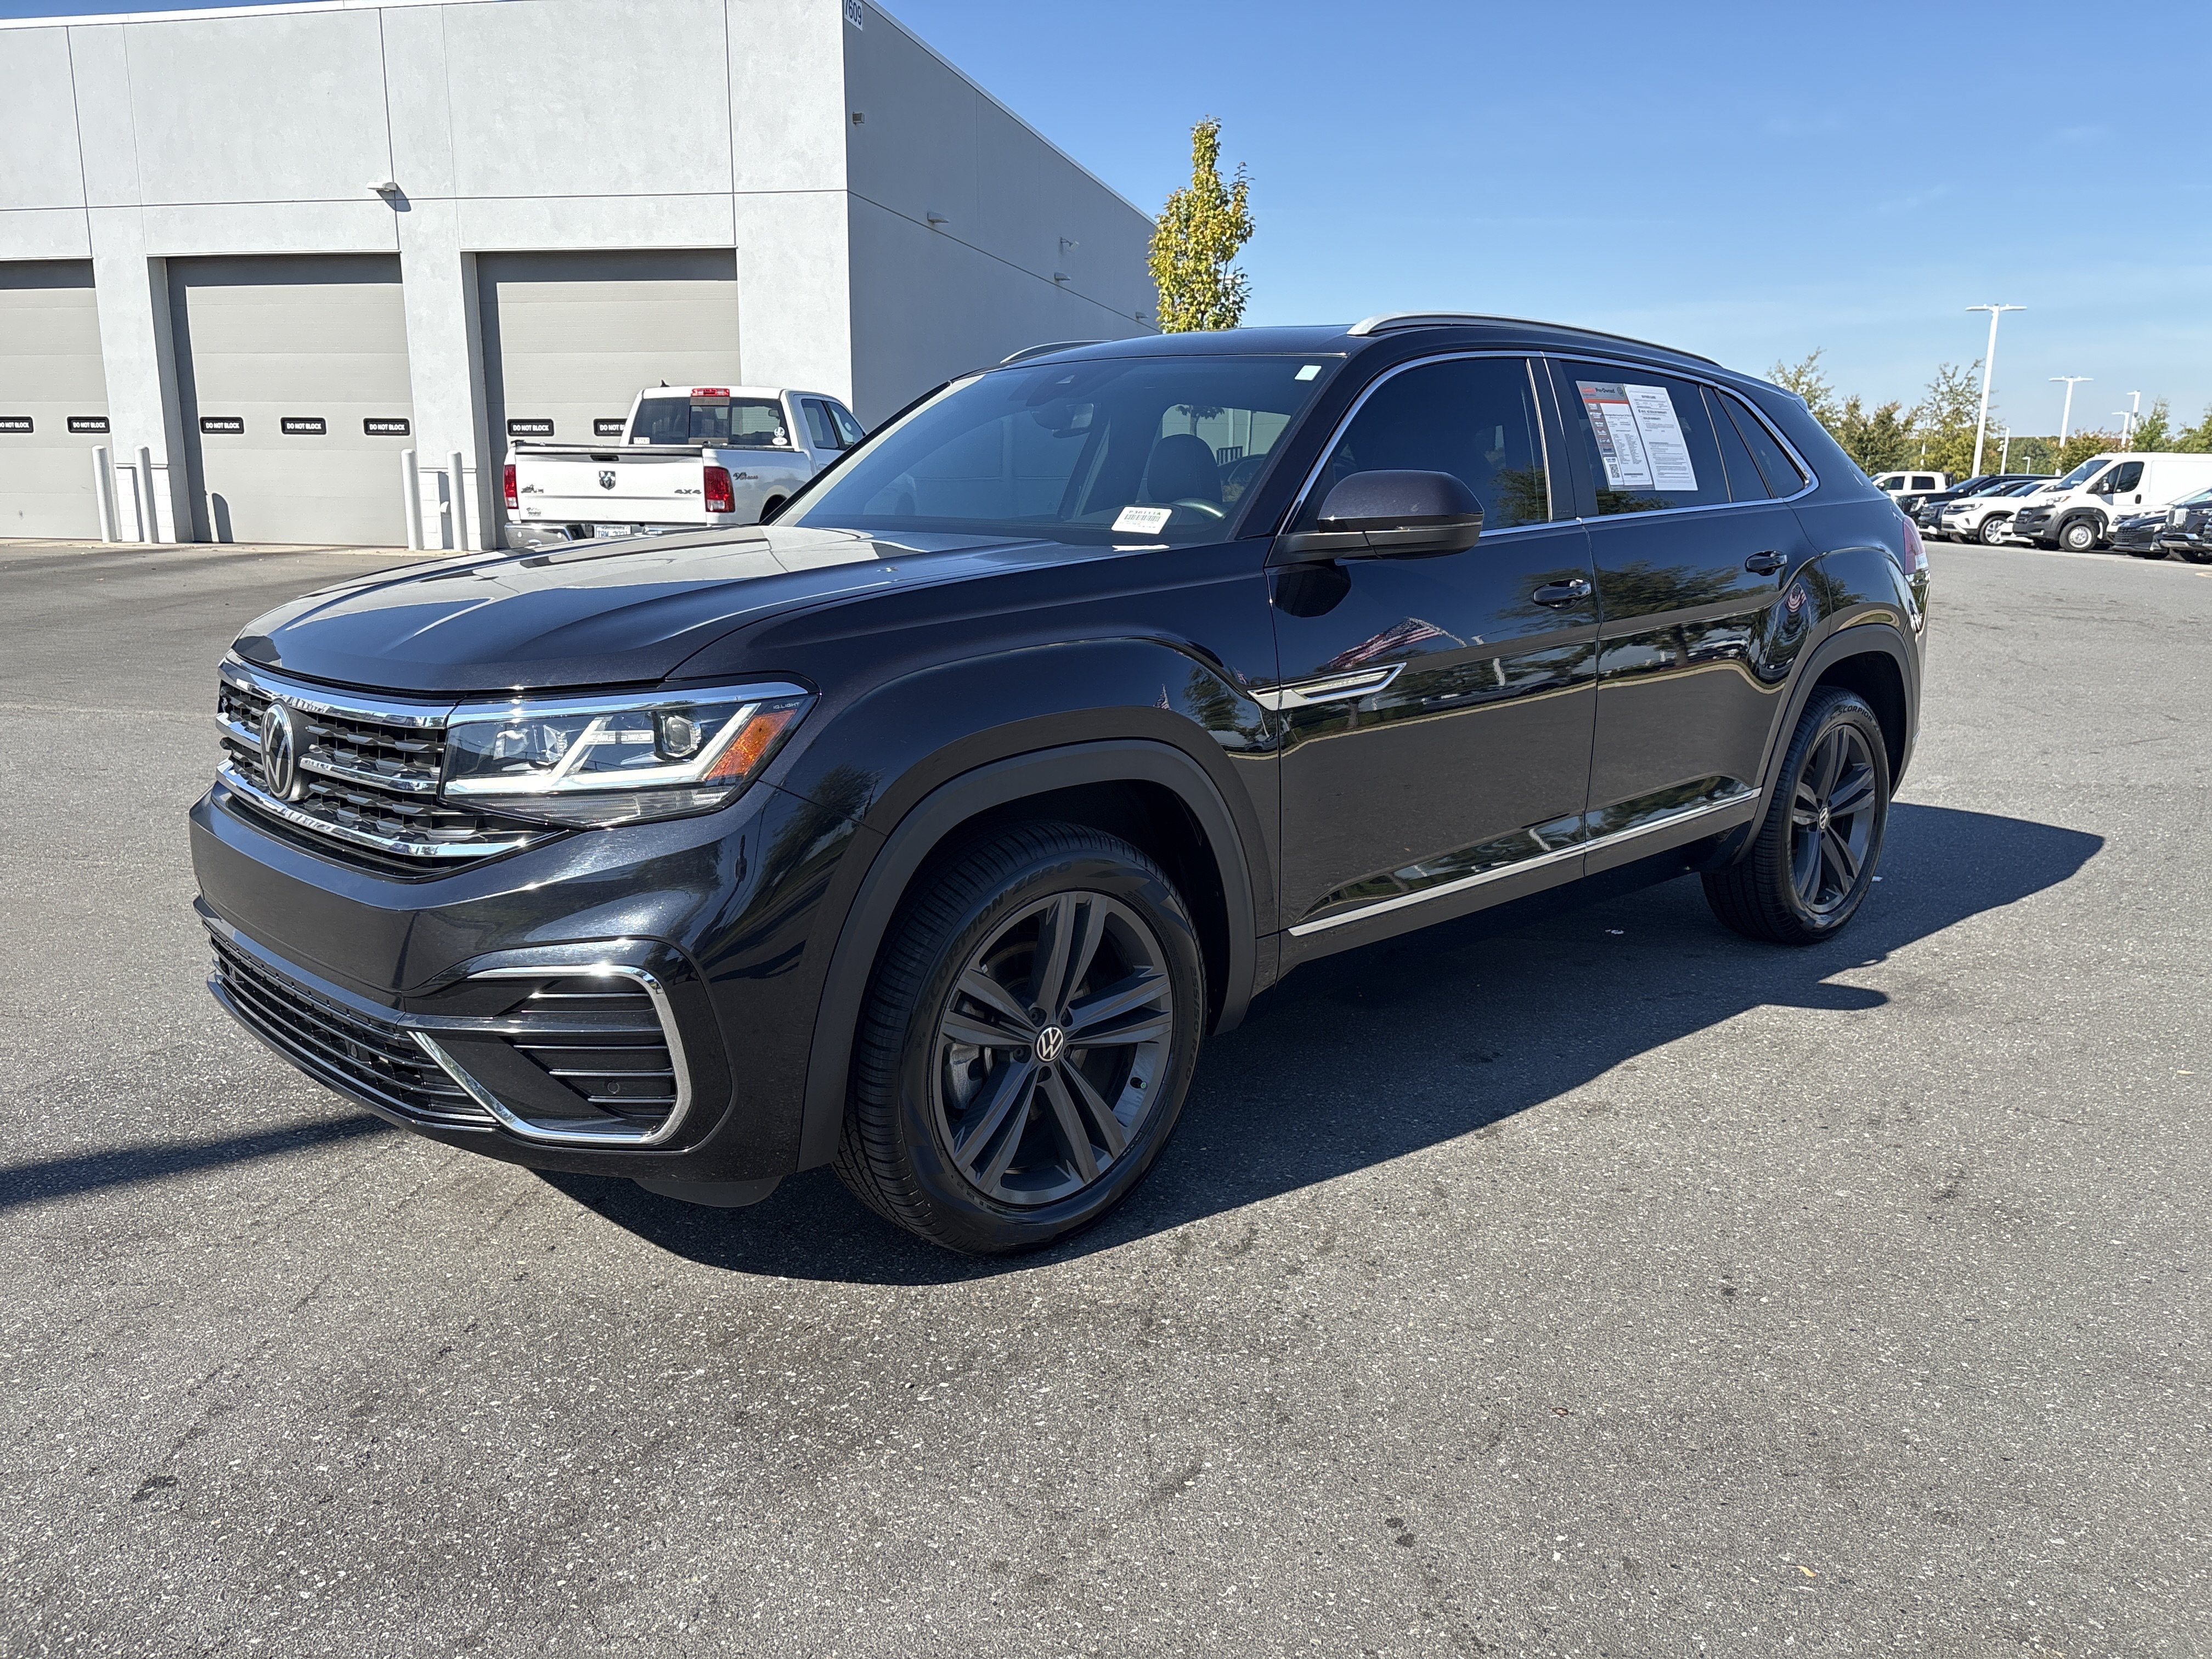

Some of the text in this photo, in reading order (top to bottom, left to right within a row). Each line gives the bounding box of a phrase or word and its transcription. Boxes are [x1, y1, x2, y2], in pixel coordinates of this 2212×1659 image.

[1837, 705, 1873, 723] SCORPION
[924, 861, 1073, 1023] SCORPION ZERO
[1185, 966, 1200, 1081] 255/50 R20
